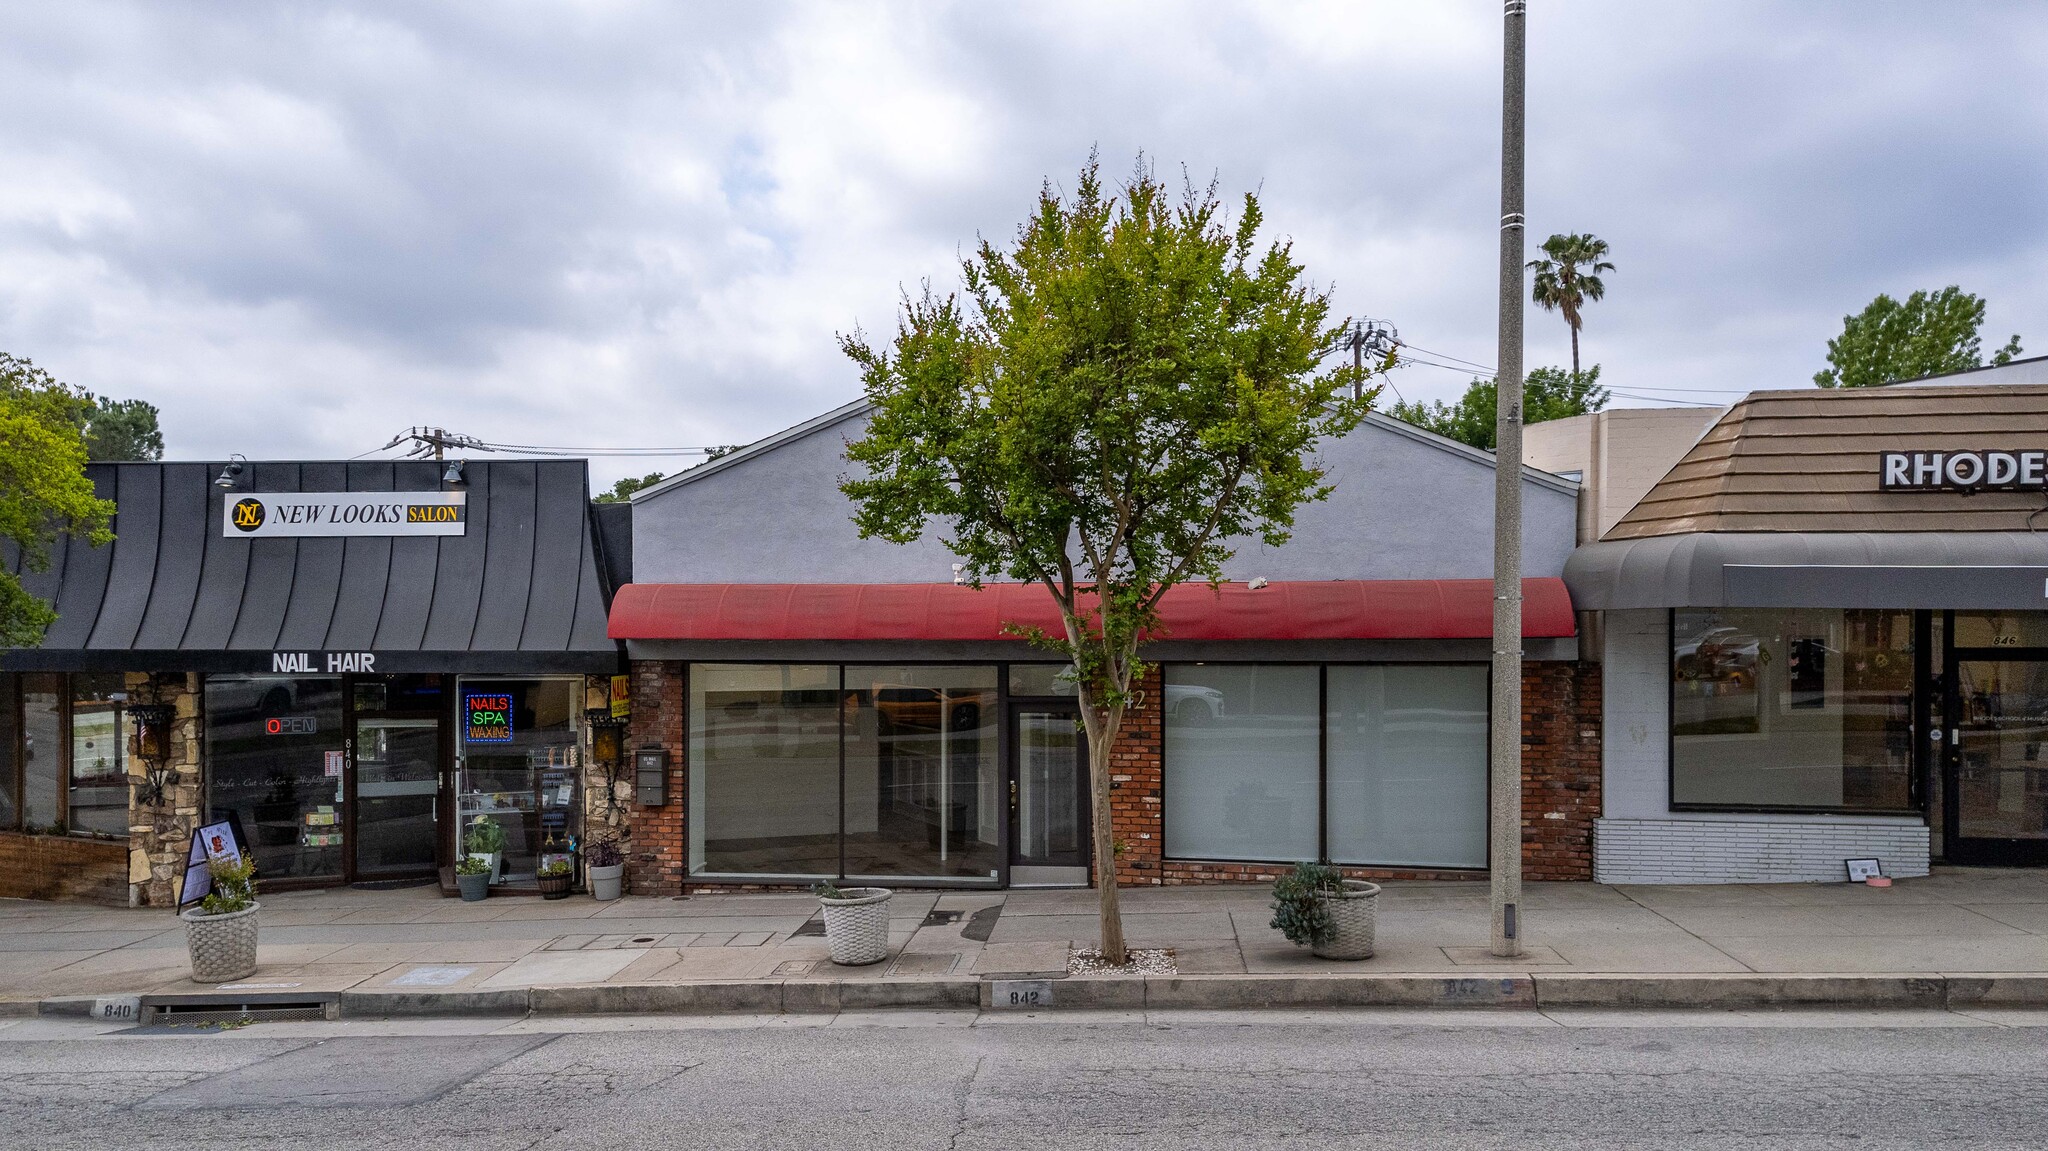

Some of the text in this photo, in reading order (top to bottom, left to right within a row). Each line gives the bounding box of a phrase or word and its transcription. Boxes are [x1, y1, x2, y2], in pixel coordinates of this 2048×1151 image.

[1885, 452, 2048, 486] RHODE
[272, 504, 458, 524] NEW LOOKS SALON
[1993, 636, 2016, 645] 846
[273, 652, 375, 673] NAIL HAIR
[470, 697, 508, 710] NAILS
[1123, 689, 1146, 710] 42
[473, 711, 506, 725] SPA
[267, 719, 314, 733] OPEN
[470, 726, 510, 739] WAXING
[242, 777, 257, 787] Cut
[265, 776, 287, 787] Color
[1010, 991, 1039, 1006] 842
[104, 1005, 131, 1018] 840
